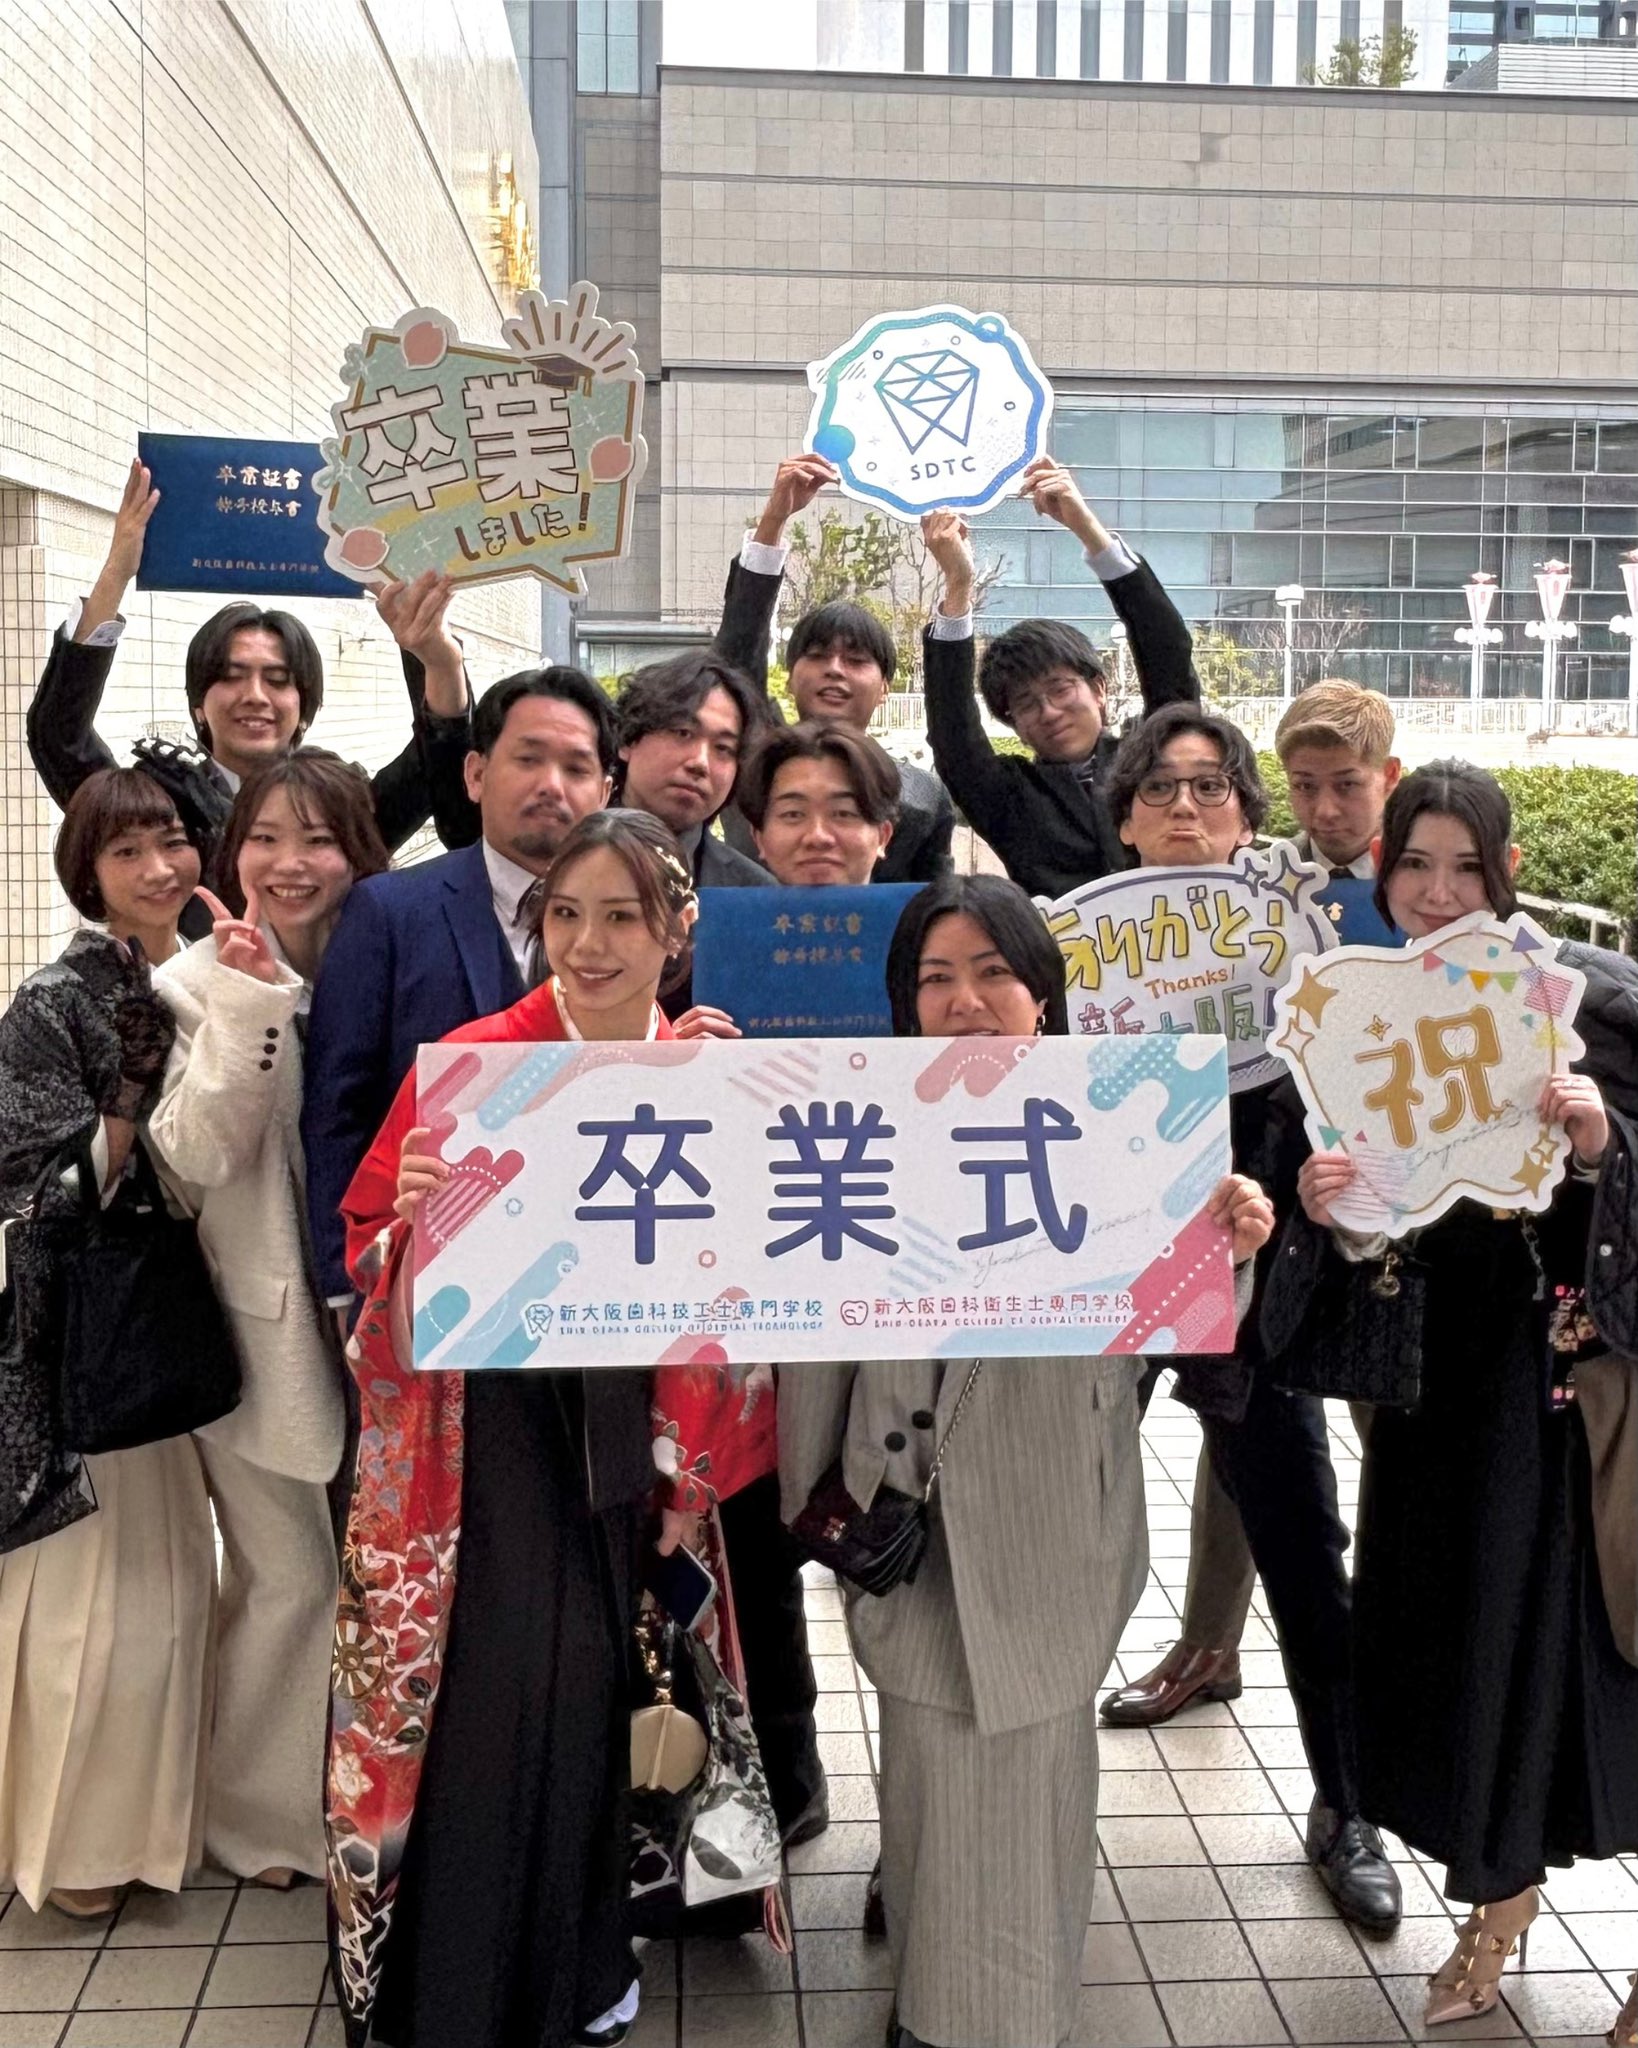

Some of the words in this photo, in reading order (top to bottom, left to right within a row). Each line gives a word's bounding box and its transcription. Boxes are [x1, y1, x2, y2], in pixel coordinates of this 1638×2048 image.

[340, 371, 579, 511] 卒業
[910, 455, 977, 481] SDTC
[455, 490, 590, 562] しました!
[1038, 884, 1287, 991] ありがとう
[1144, 963, 1236, 999] Thanks!
[1354, 1003, 1502, 1148] 祝
[574, 1097, 1088, 1266] 卒業式
